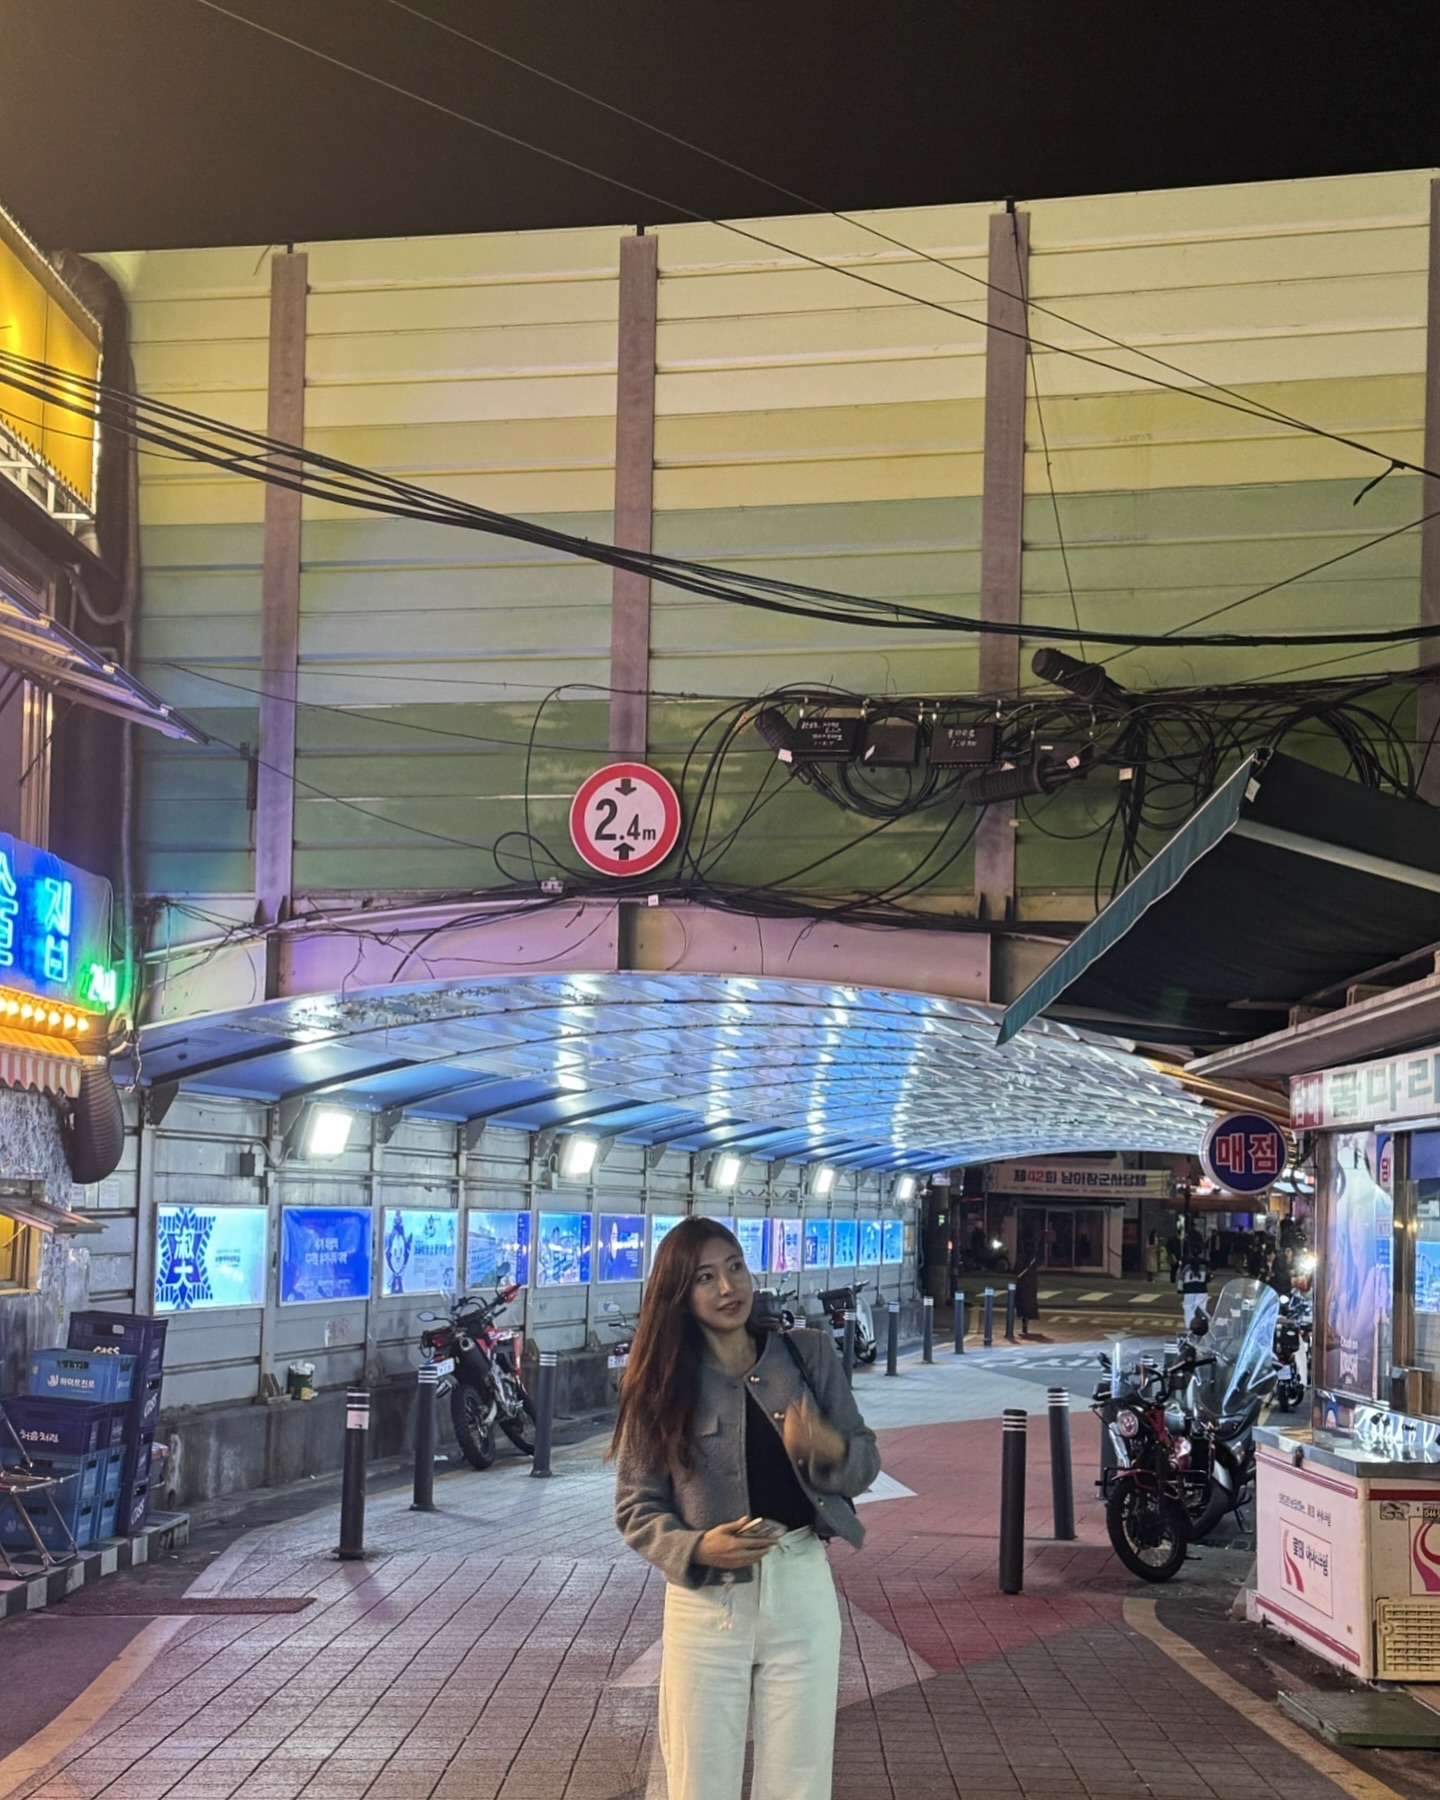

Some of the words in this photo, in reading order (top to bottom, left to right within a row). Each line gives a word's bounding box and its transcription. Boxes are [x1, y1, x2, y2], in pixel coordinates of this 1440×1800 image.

[594, 798, 656, 841] 2.4m
[1216, 1132, 1278, 1174] 매점
[1013, 1169, 1057, 1183] 제42회
[59, 1377, 95, 1389] 하이트진로
[19, 1429, 59, 1443] 처음처럼
